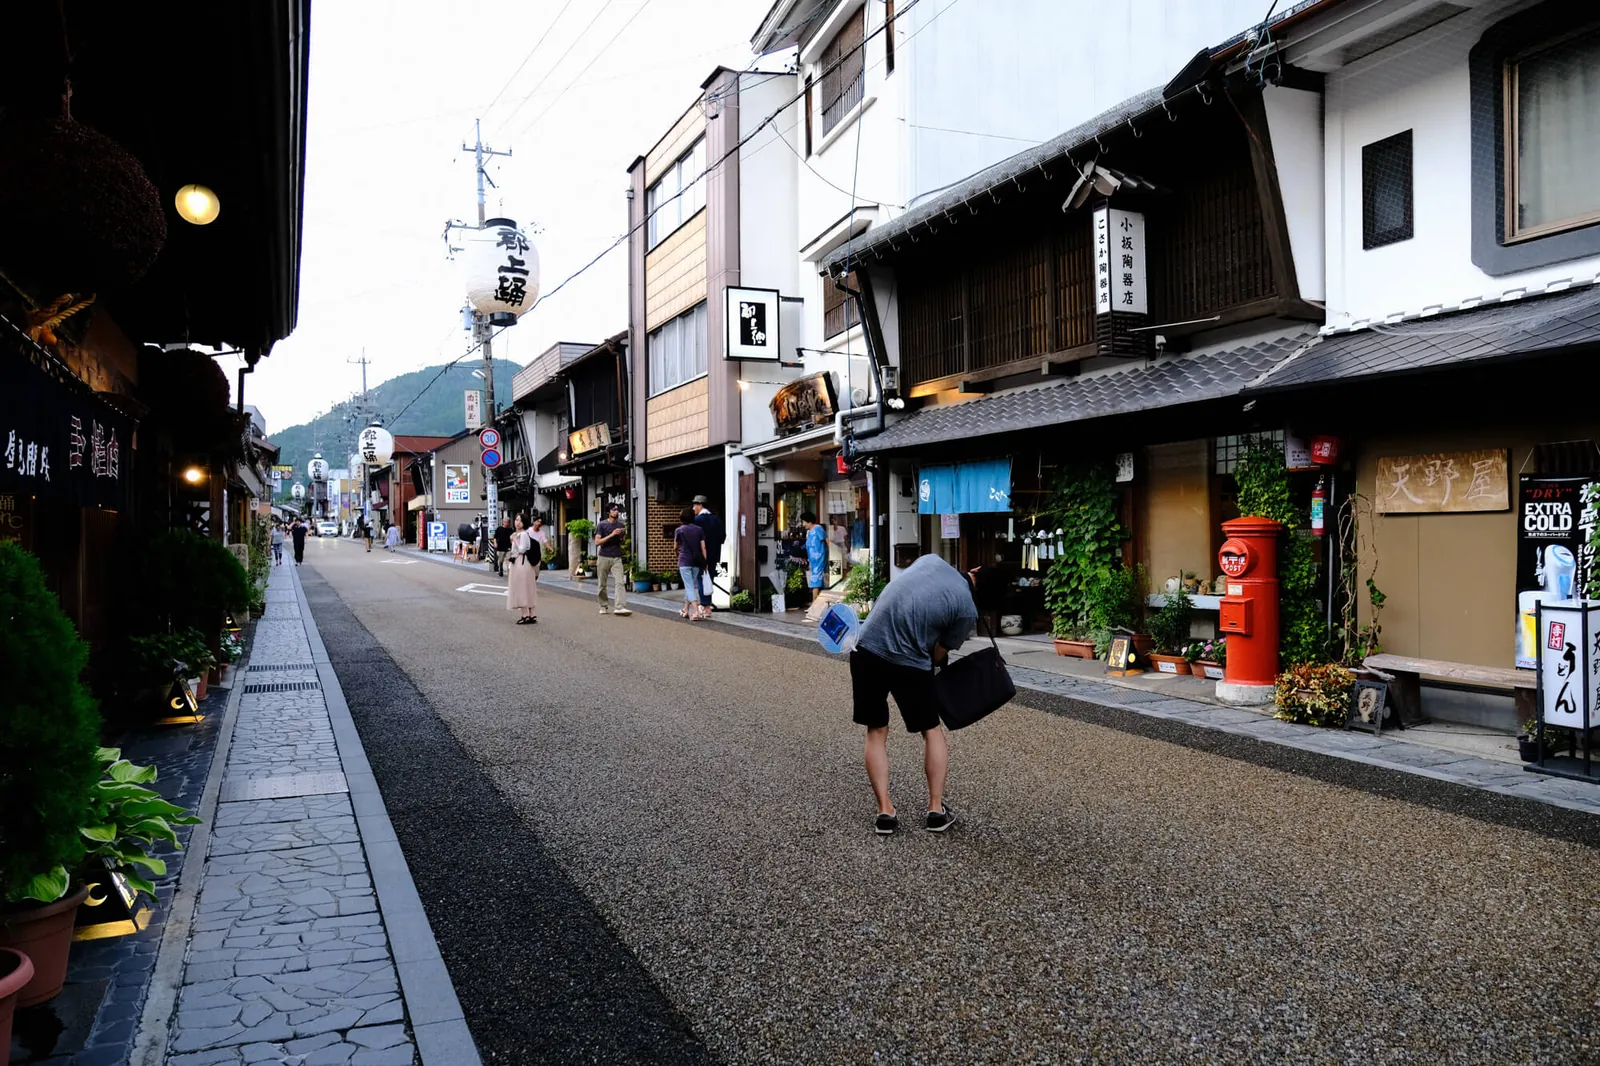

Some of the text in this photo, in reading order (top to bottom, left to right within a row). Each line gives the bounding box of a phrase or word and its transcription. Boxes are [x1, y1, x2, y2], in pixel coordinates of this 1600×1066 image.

[1097, 218, 1108, 305] こさか陶器店
[1120, 216, 1135, 306] 小坂陶器店
[484, 433, 496, 444] 30
[1386, 457, 1501, 506] 天野屋
[1524, 502, 1573, 515] EXTRA
[431, 523, 444, 537] P
[1524, 514, 1573, 531] COLD
[1225, 564, 1242, 572] POST
[1555, 641, 1577, 714] うどん
